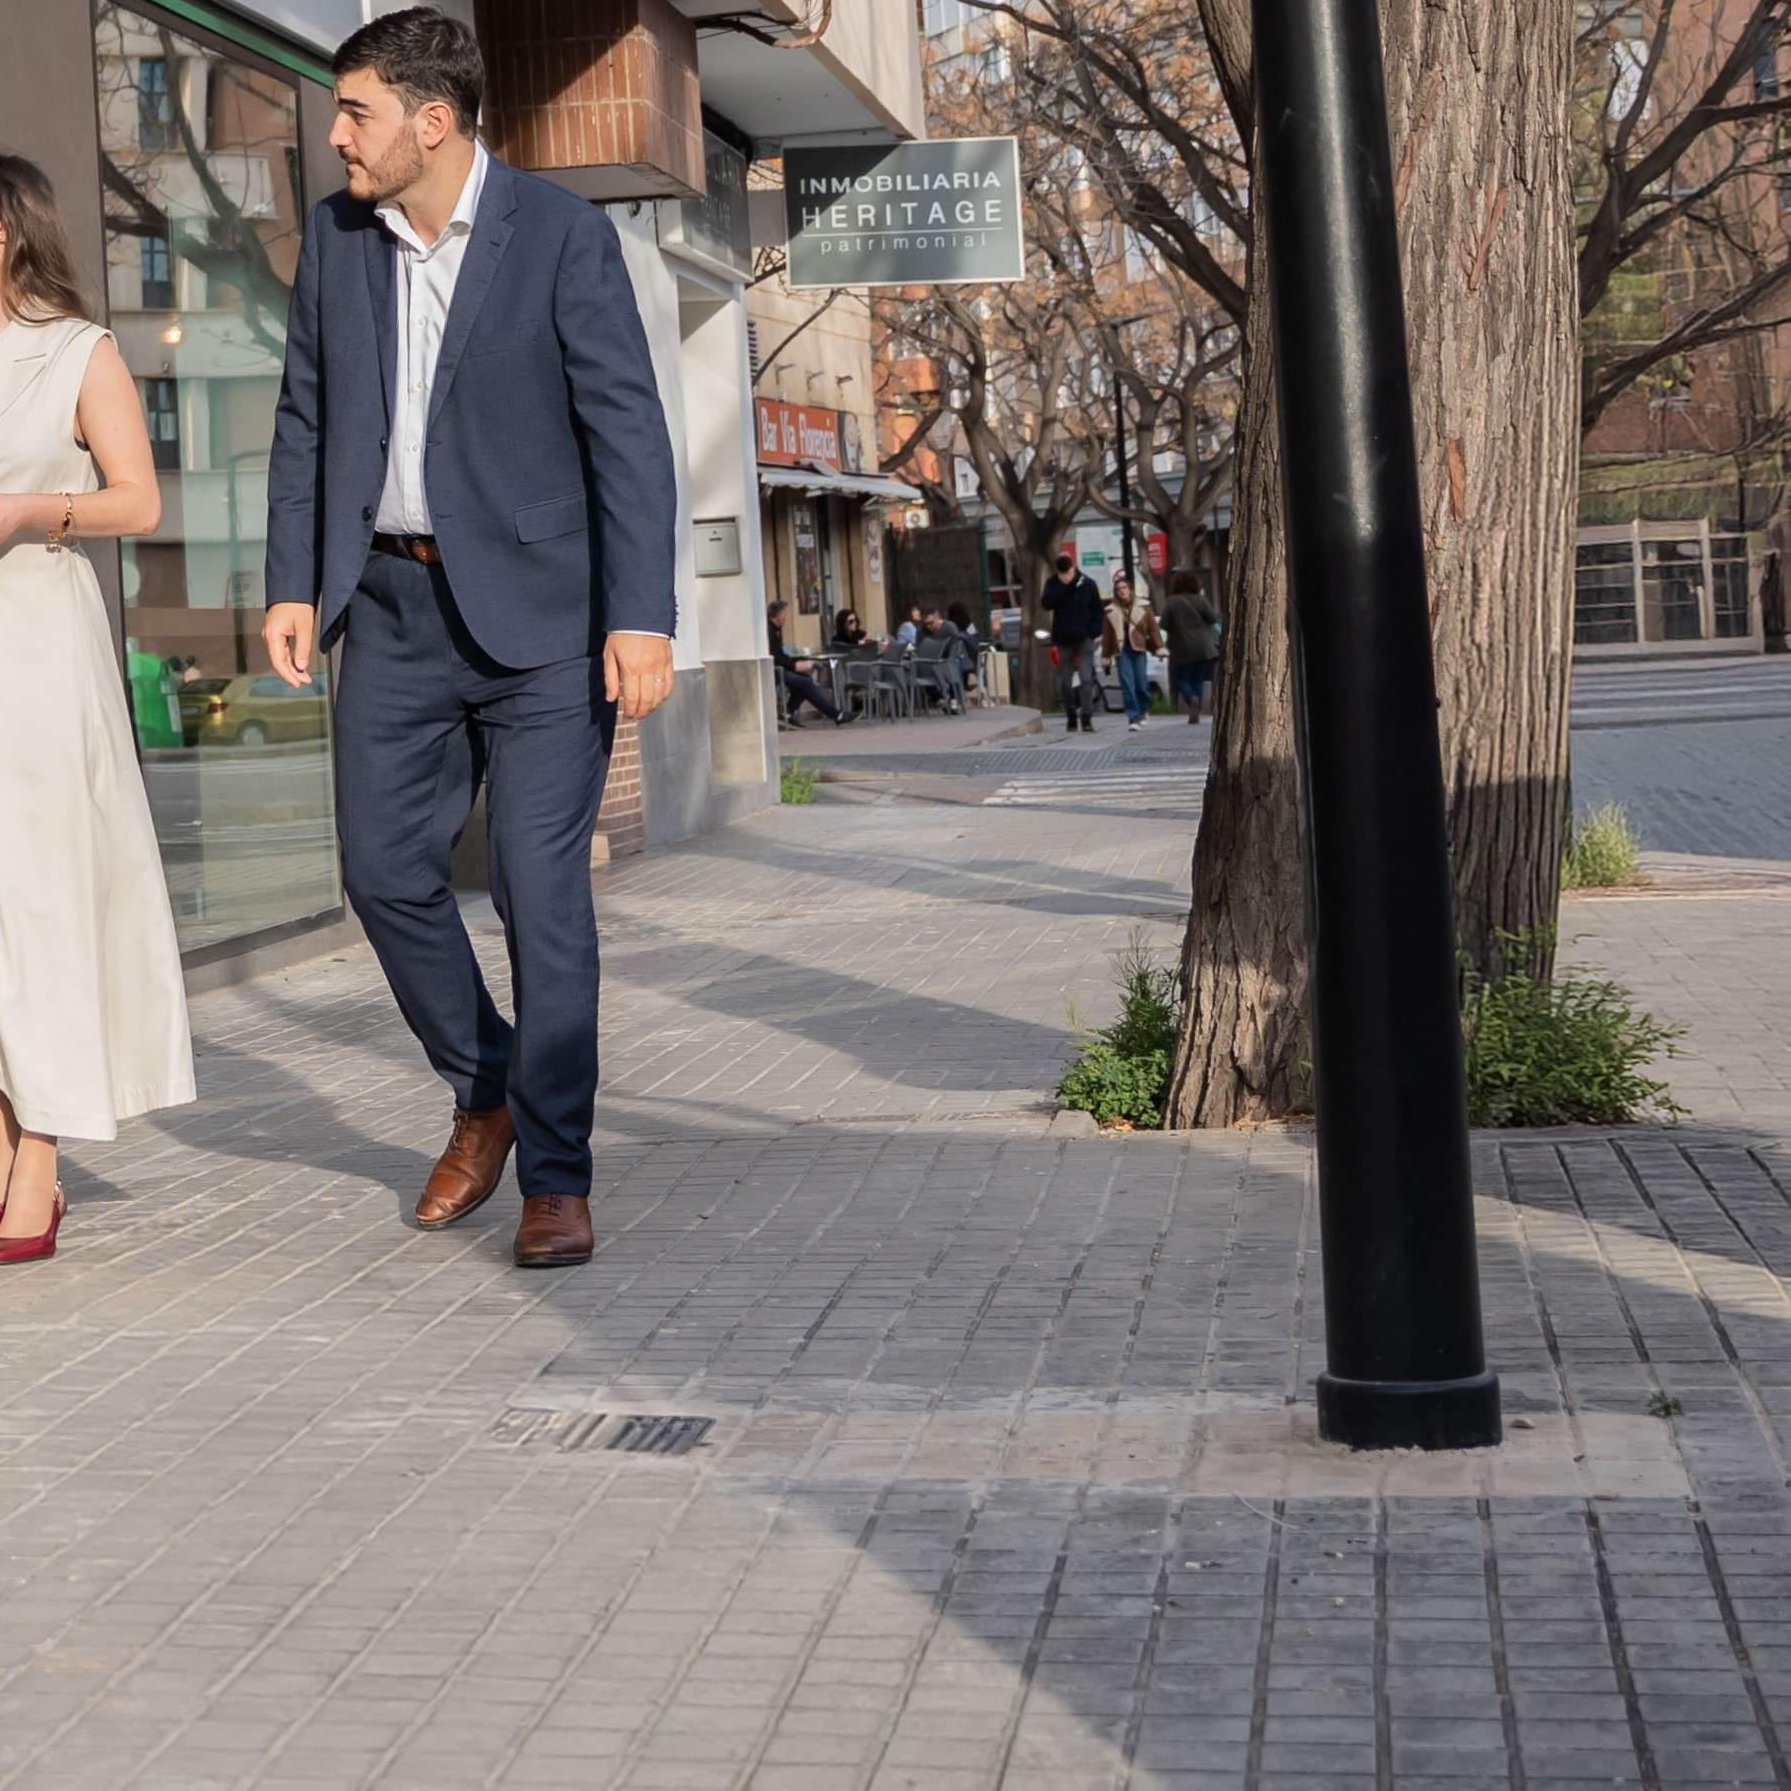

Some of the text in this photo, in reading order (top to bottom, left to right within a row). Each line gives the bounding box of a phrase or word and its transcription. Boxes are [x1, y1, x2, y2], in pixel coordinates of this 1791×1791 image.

[800, 171, 1001, 195] INMOBILIARIA
[802, 199, 1003, 230] HERITAGE
[821, 234, 986, 256] patrimonial
[760, 406, 777, 452] Bar
